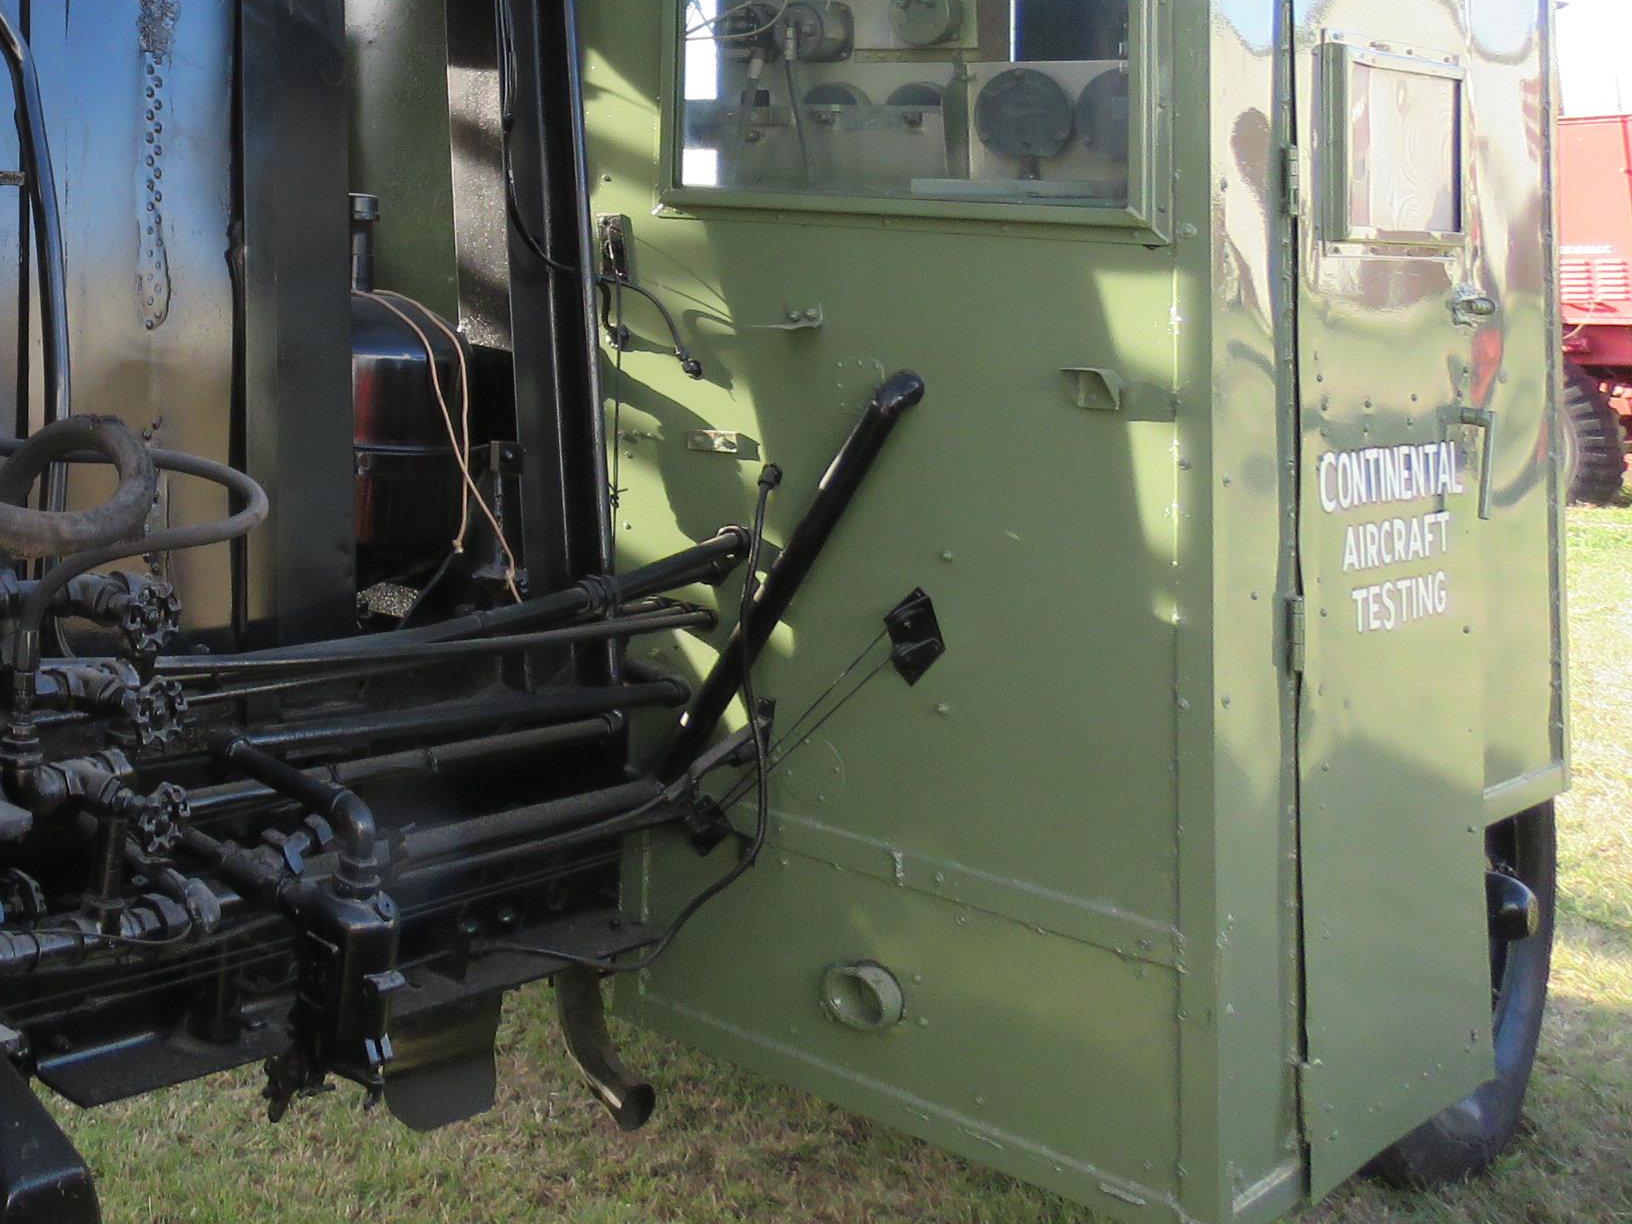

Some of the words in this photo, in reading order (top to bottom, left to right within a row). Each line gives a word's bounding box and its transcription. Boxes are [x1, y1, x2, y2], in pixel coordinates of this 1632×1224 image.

[1319, 441, 1463, 513] CONTINENTAL
[1342, 511, 1449, 572] AIRCRAFT
[1351, 570, 1447, 633] TESTING
